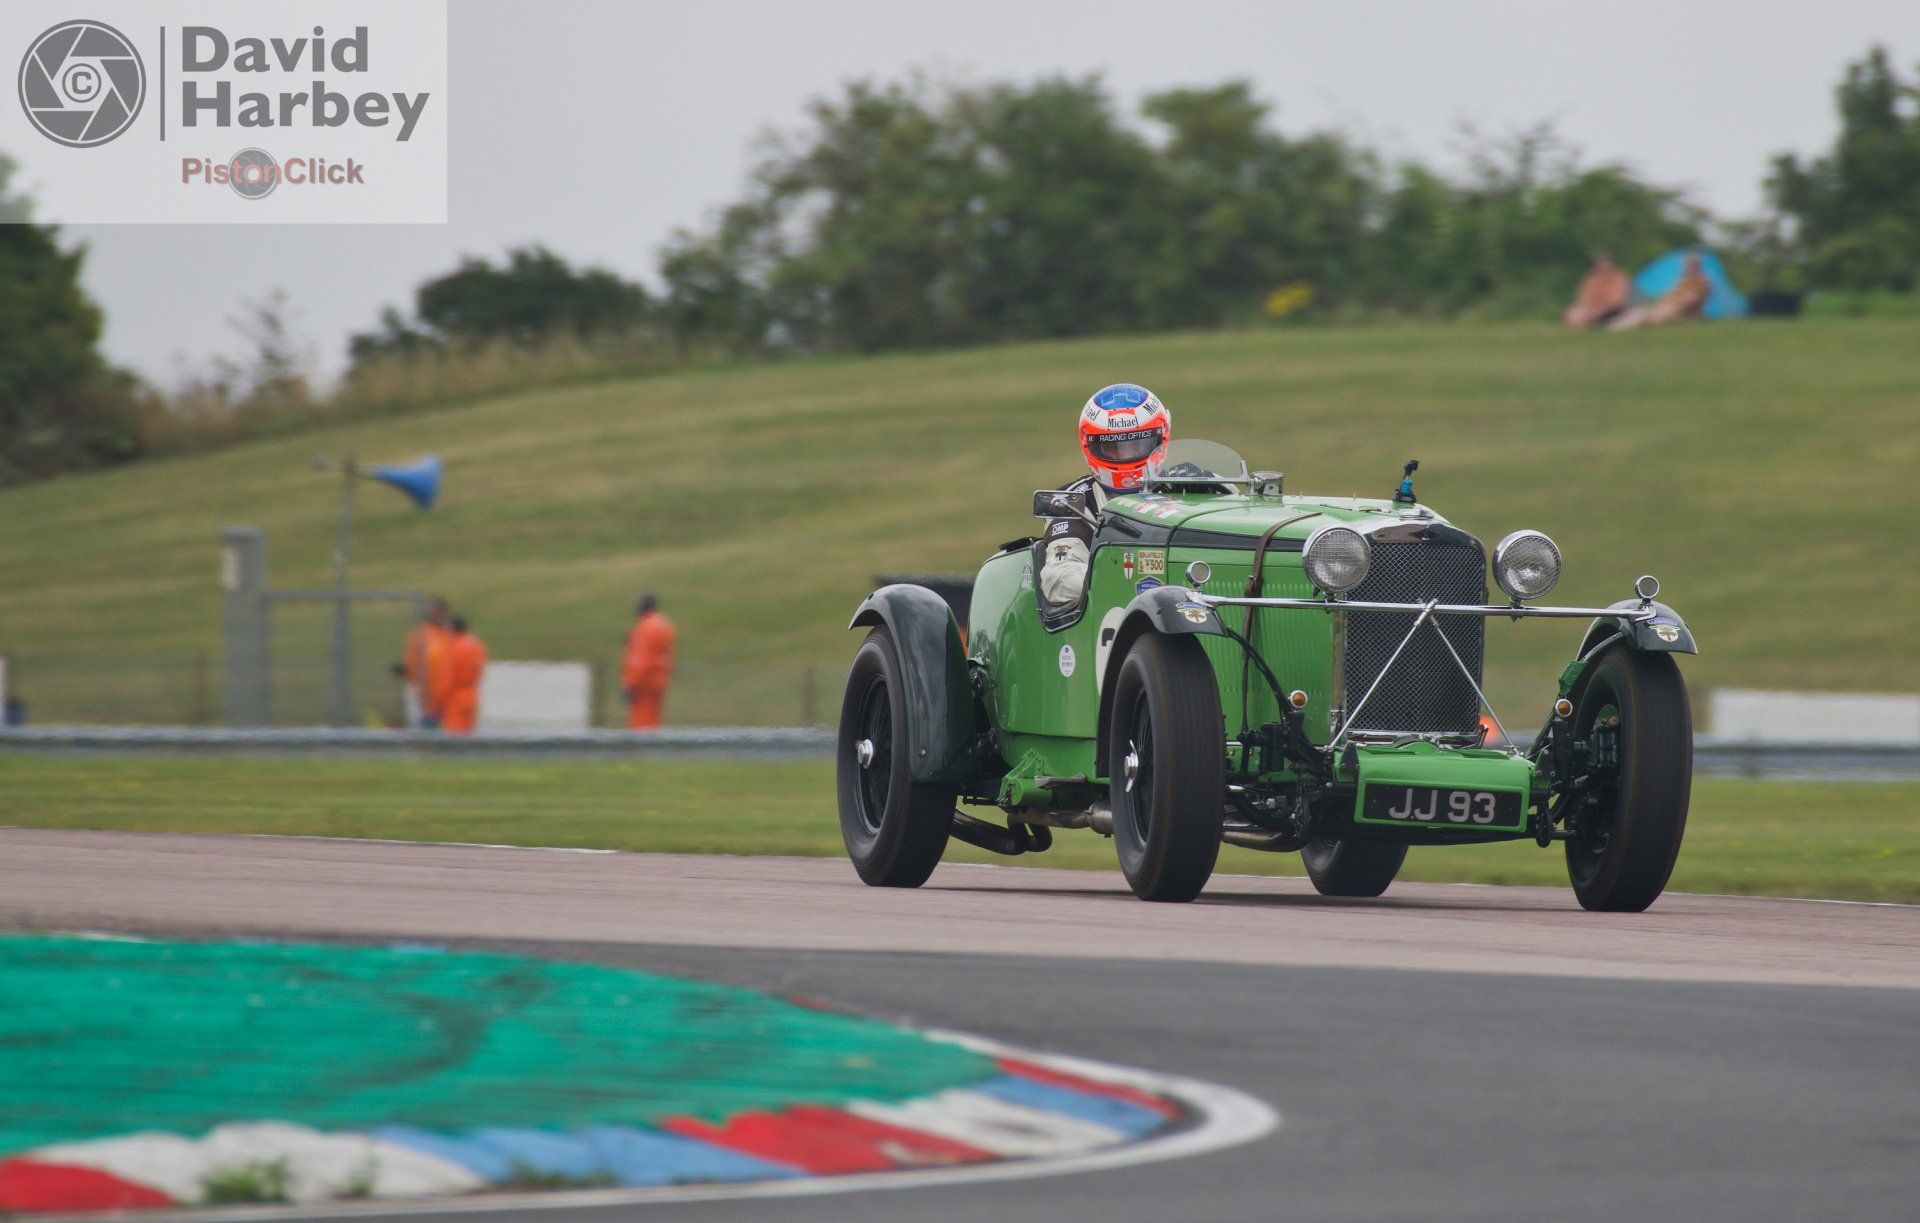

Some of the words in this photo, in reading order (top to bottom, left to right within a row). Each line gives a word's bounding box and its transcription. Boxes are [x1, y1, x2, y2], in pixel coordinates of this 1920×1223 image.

[1107, 416, 1138, 428] Michael
[1100, 433, 1126, 442] RACING
[1127, 430, 1152, 440] OPTICS
[1052, 524, 1068, 533] OMP
[1389, 788, 1438, 821] JJ
[1447, 791, 1496, 824] 93
